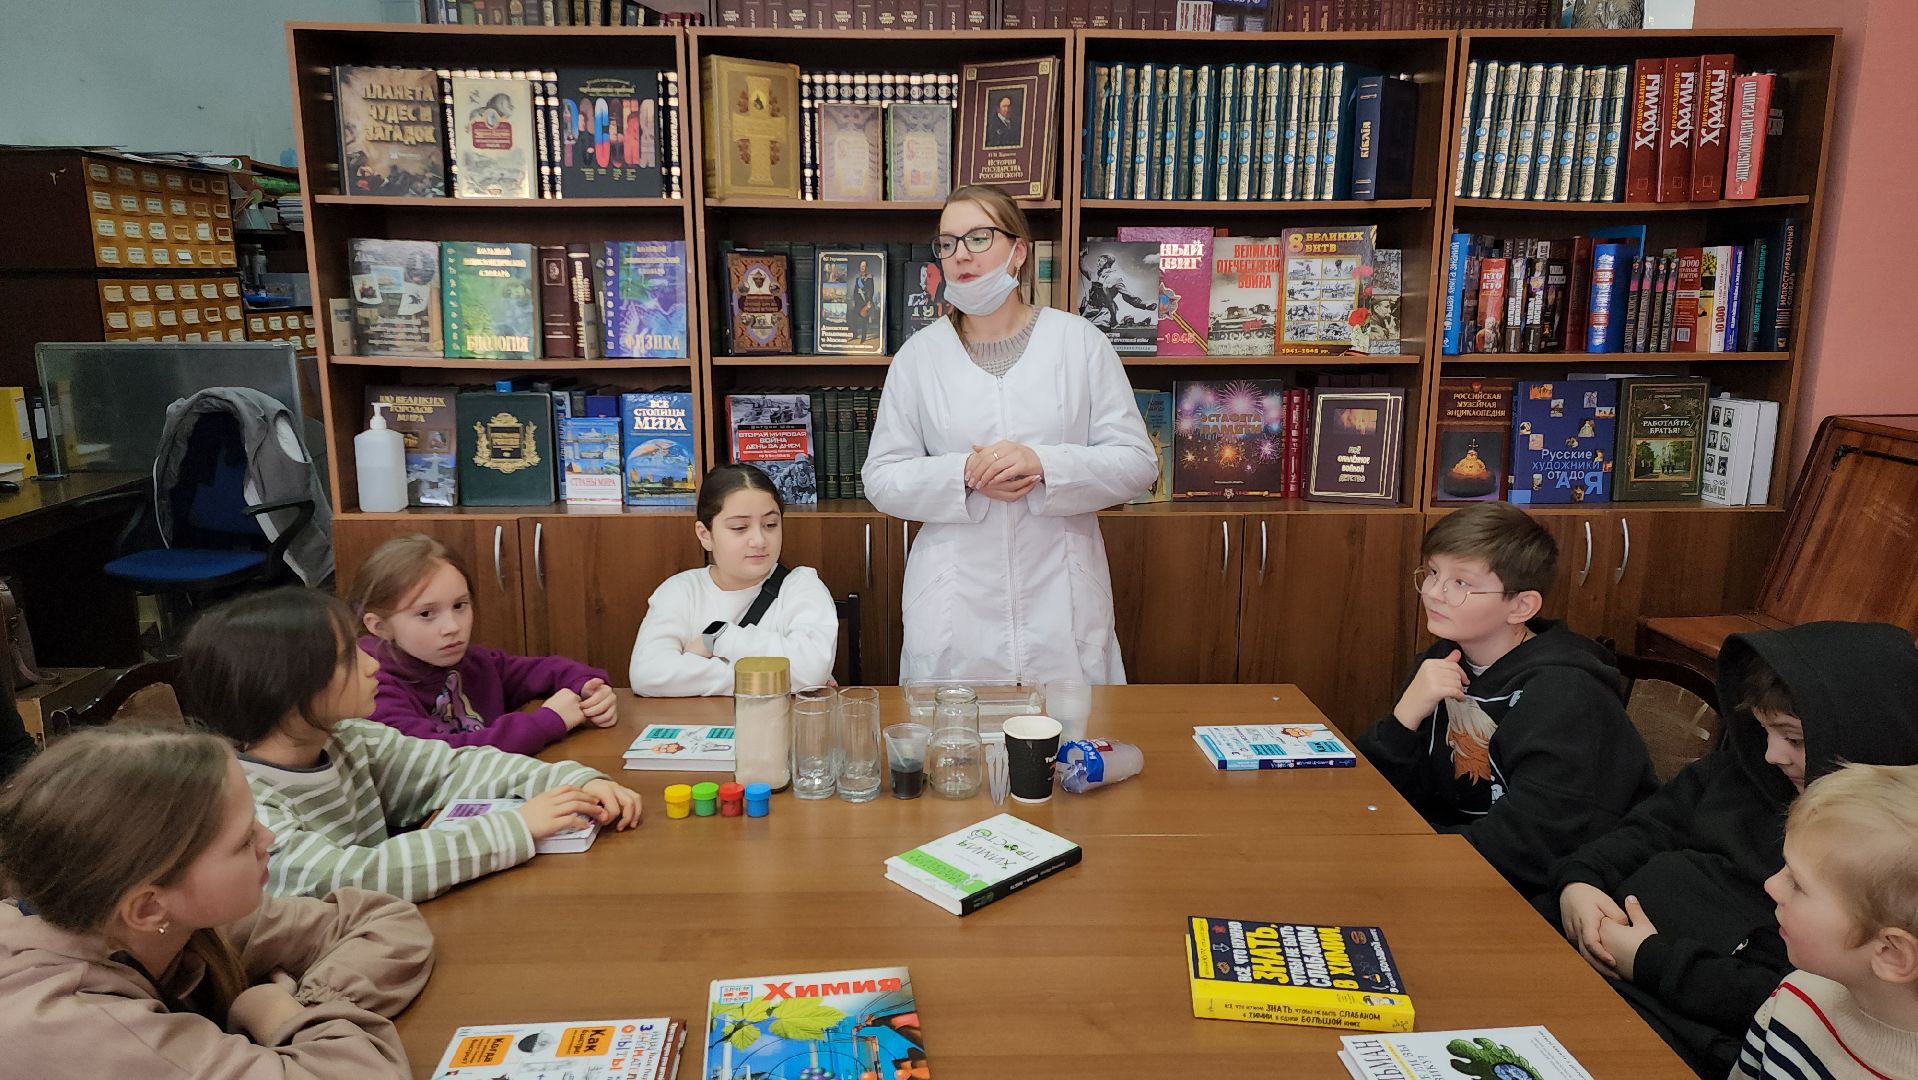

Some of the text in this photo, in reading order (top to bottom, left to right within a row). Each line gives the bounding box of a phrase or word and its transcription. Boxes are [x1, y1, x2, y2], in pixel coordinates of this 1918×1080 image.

[363, 83, 435, 101] ПЛАНЕТА
[368, 104, 432, 124] ЧУДЕС И
[1635, 74, 1661, 150] Храмы
[1670, 72, 1695, 148] Храмы
[1700, 70, 1726, 147] Храмы
[366, 123, 436, 145] ЗАГАДОК
[1288, 232, 1364, 252] 8 ВЕЛИКИХ
[1305, 244, 1336, 252] БИТВ
[1234, 244, 1280, 258] ВЕЛИКАЯ
[1780, 225, 1795, 306] ИЛЛЮСТРИРОВАННЫЙ
[1238, 274, 1271, 288] ВОЙНА
[466, 335, 529, 352] БИОЛОГИЯ
[625, 335, 680, 350] ФИЗИКА
[650, 400, 669, 408] ВСЕ
[1454, 392, 1502, 400] РОССИЙСКАЯ
[1457, 400, 1497, 408] МУЗЕЙНАЯ
[633, 408, 686, 417] СТОЛИЦЫ
[1447, 409, 1506, 417] ЭНЦИКЛОПЕДИЯ
[633, 417, 687, 430] МИРА
[1541, 449, 1592, 461] Русские
[1532, 461, 1600, 470] художники
[1556, 472, 1571, 489] А
[1584, 471, 1604, 495] Я
[956, 840, 1017, 869] ХИМИЯ
[1246, 924, 1290, 984] ЗНАТЬ,
[1280, 925, 1305, 985] ЧТОБЫ НЕ БЫТЬ
[1296, 926, 1332, 987] СЛАБАКОМ
[1333, 978, 1359, 990] В
[1266, 1004, 1293, 1013] ЗНАТЬ
[1339, 1010, 1380, 1020] СЛАБАКОМ
[1301, 1015, 1342, 1026] БОЛЬШОЙ
[587, 1028, 607, 1053] Как
[483, 1037, 504, 1064] Когда
